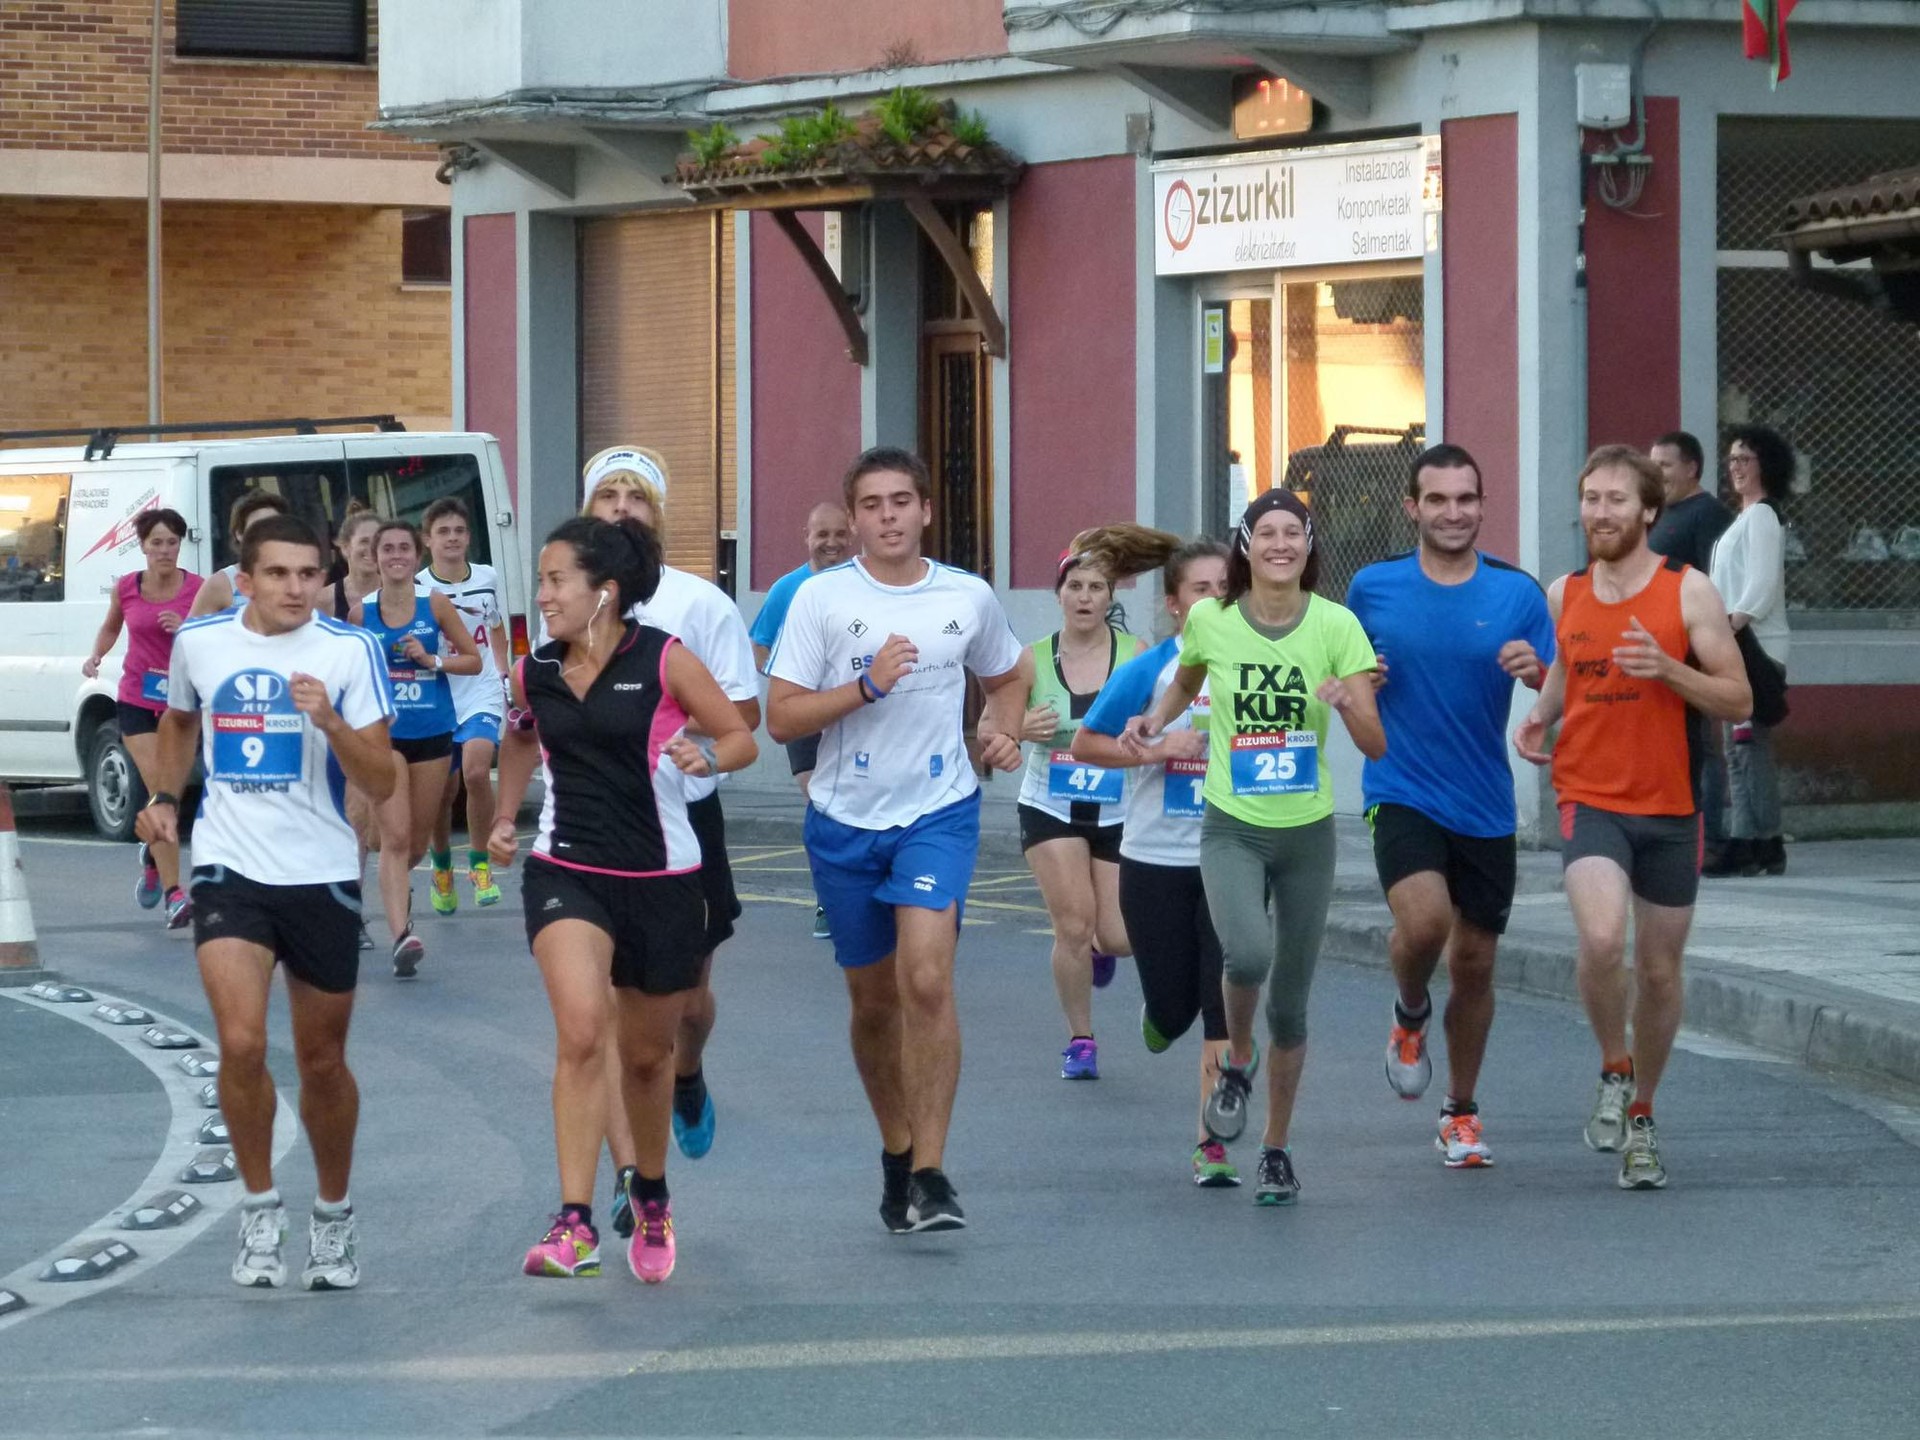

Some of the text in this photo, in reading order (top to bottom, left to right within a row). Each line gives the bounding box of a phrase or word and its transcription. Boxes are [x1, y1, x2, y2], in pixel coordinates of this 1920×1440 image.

[1345, 158, 1411, 184] Instalazioak
[1197, 166, 1295, 225] zizurkil
[1338, 196, 1411, 223] Konponketak
[1352, 230, 1412, 255] Salmentak
[233, 674, 283, 701] SD
[394, 682, 421, 701] 20
[1240, 663, 1308, 694] TXA
[1233, 692, 1307, 723] KUR
[241, 736, 265, 768] 9
[1287, 734, 1315, 744] KROSS
[1068, 767, 1105, 791] 47
[1255, 751, 1297, 781] 25
